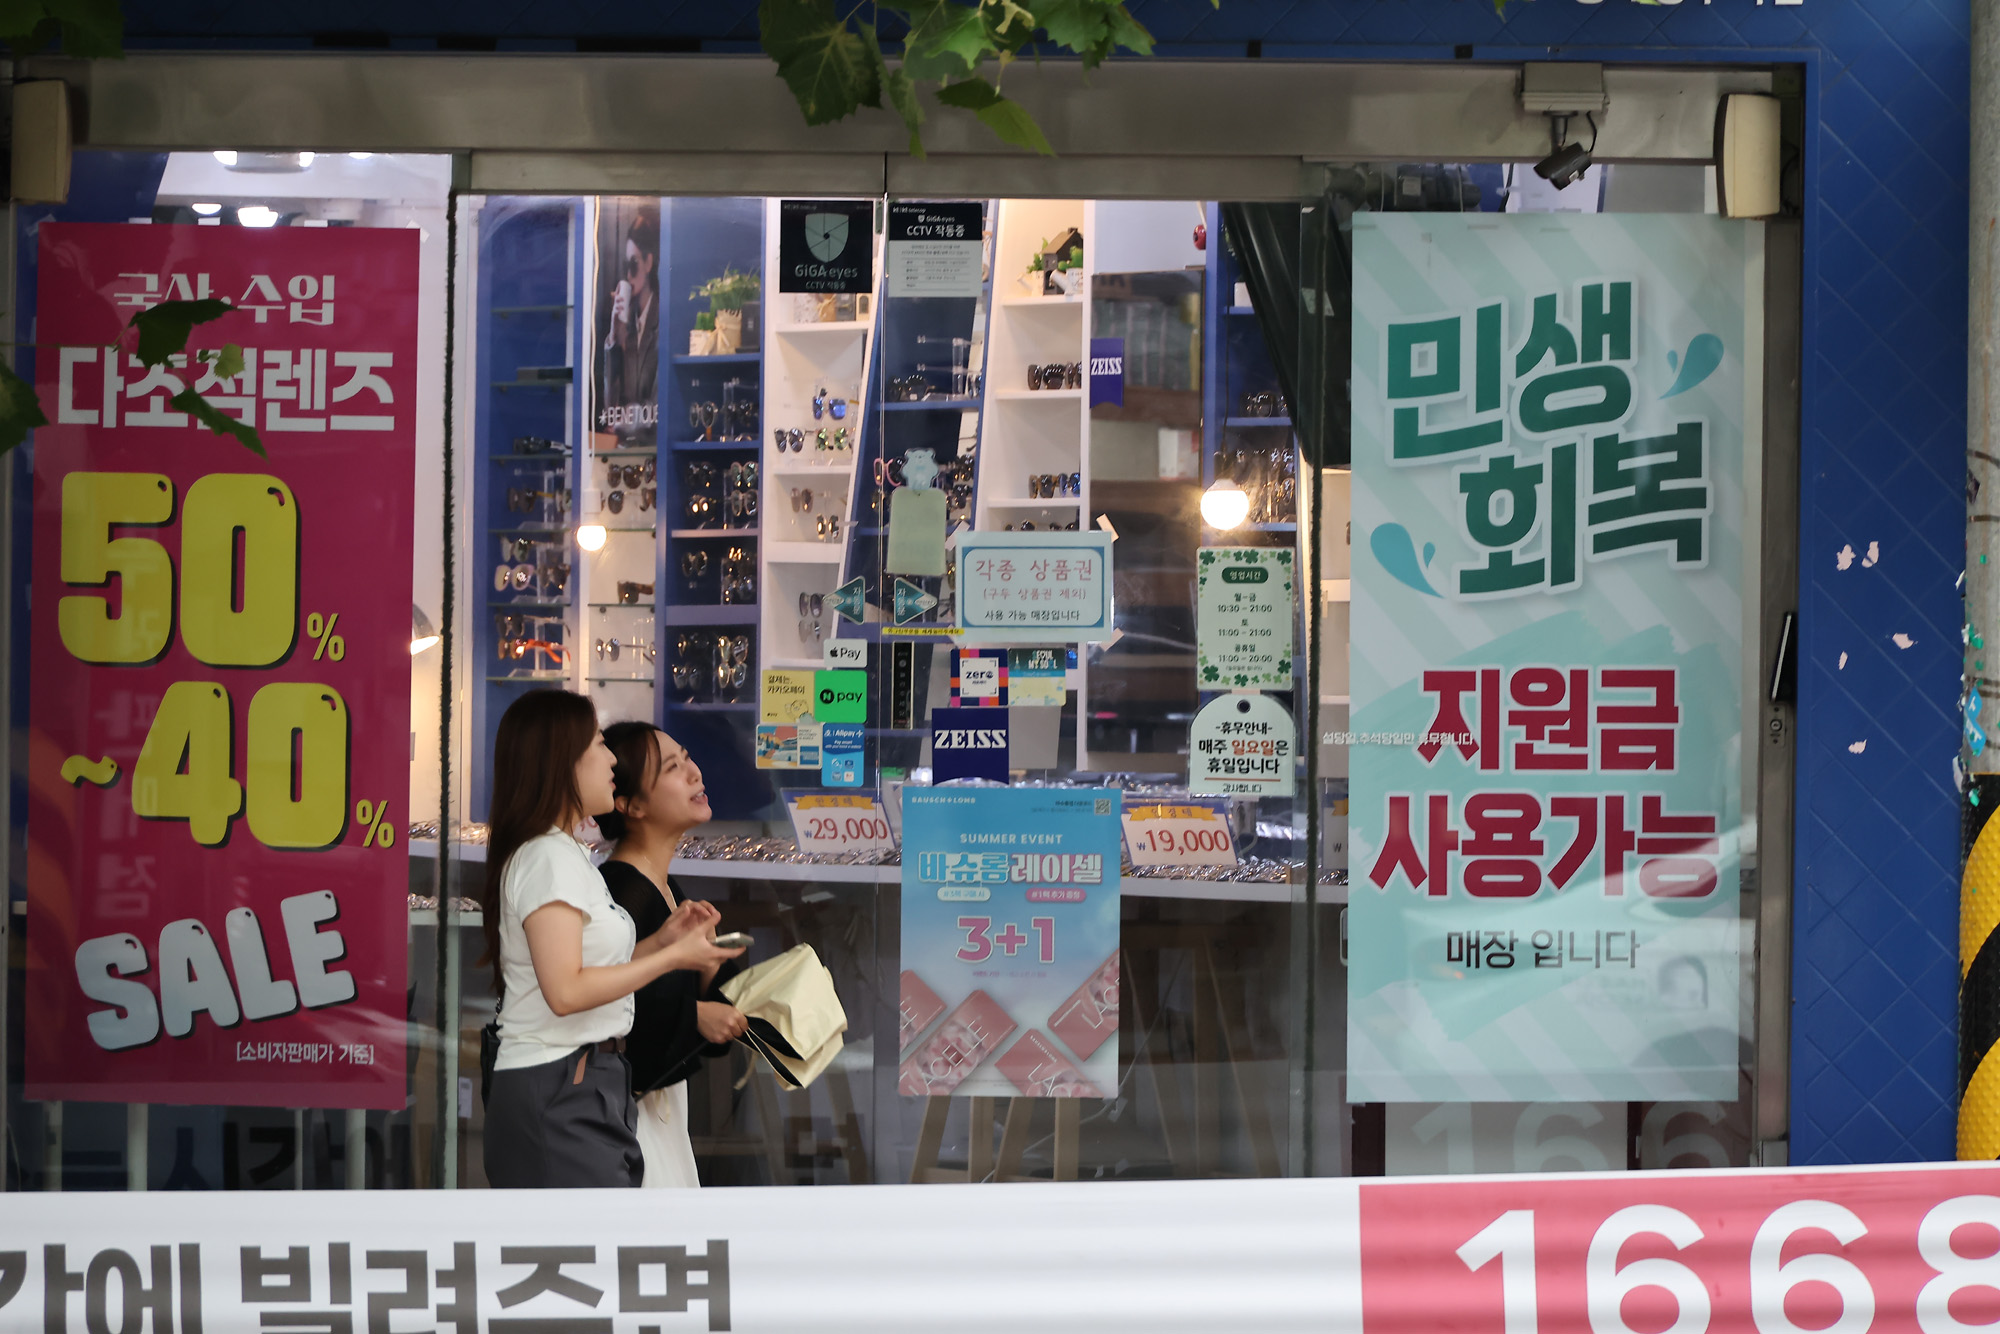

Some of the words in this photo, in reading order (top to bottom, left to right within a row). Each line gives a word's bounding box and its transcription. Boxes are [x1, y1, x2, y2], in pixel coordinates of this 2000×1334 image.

[906, 225, 933, 236] CCTV
[805, 281, 825, 290] CCTV
[1091, 357, 1122, 376] ZEISS
[1385, 279, 1634, 461] 민생
[1457, 420, 1708, 595] 회복
[58, 470, 346, 667] 50%
[975, 559, 1017, 582] 각종
[1030, 559, 1092, 582] 상품권
[1229, 571, 1261, 580] 영업시간
[1018, 588, 1052, 600] 상품권
[1059, 588, 1087, 600] 제외)
[984, 610, 1004, 621] 사용
[1008, 610, 1027, 621] 가능
[1030, 610, 1080, 621] 매장입니다
[1217, 604, 1240, 613] 10:30
[1249, 604, 1273, 613] 21:00
[1217, 628, 1240, 637] 11:00
[1249, 628, 1273, 637] 21:00
[840, 647, 861, 660] Pay
[1218, 654, 1240, 663] 11:00
[1249, 654, 1273, 663] 20:00
[836, 691, 863, 704] pay
[1416, 667, 1680, 771] 지원금
[934, 729, 1007, 749] ZEISS
[1198, 739, 1228, 754] 매주
[1231, 739, 1289, 756] 일요일은
[1207, 757, 1281, 774] 휴일입니다
[960, 833, 1016, 844] SUMMER
[1021, 833, 1063, 844] EVENT
[1367, 791, 1720, 899] 사용가능
[955, 914, 1056, 964] 3+1
[1446, 929, 1518, 969] 매장
[1530, 928, 1640, 969] 입니다
[75, 889, 356, 1052] SALE
[236, 1041, 334, 1064] [소비자판매가
[338, 1044, 375, 1065] 기준]
[1455, 1195, 2000, 1334] 1668
